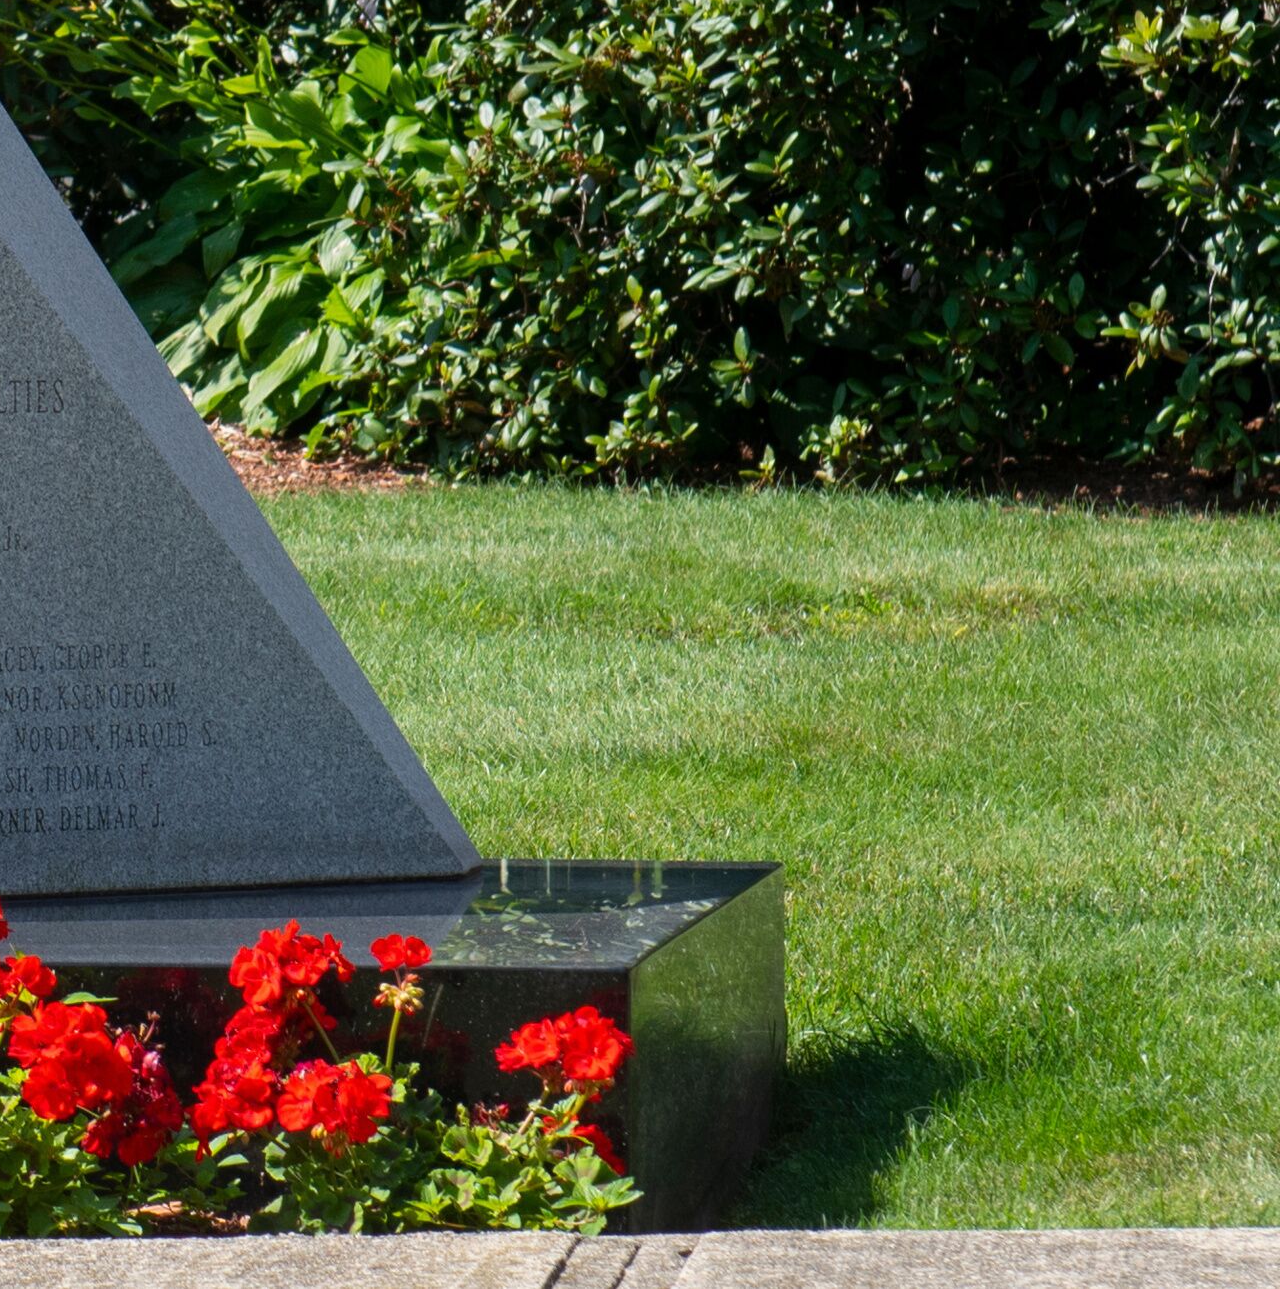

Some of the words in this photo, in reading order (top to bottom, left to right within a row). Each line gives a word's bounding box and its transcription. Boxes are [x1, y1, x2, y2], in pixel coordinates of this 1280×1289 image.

[52, 643, 130, 671] GEORGE
[109, 721, 188, 751] HAROLD
[42, 764, 128, 792] THOMAS
[59, 804, 140, 832] DELMAR
